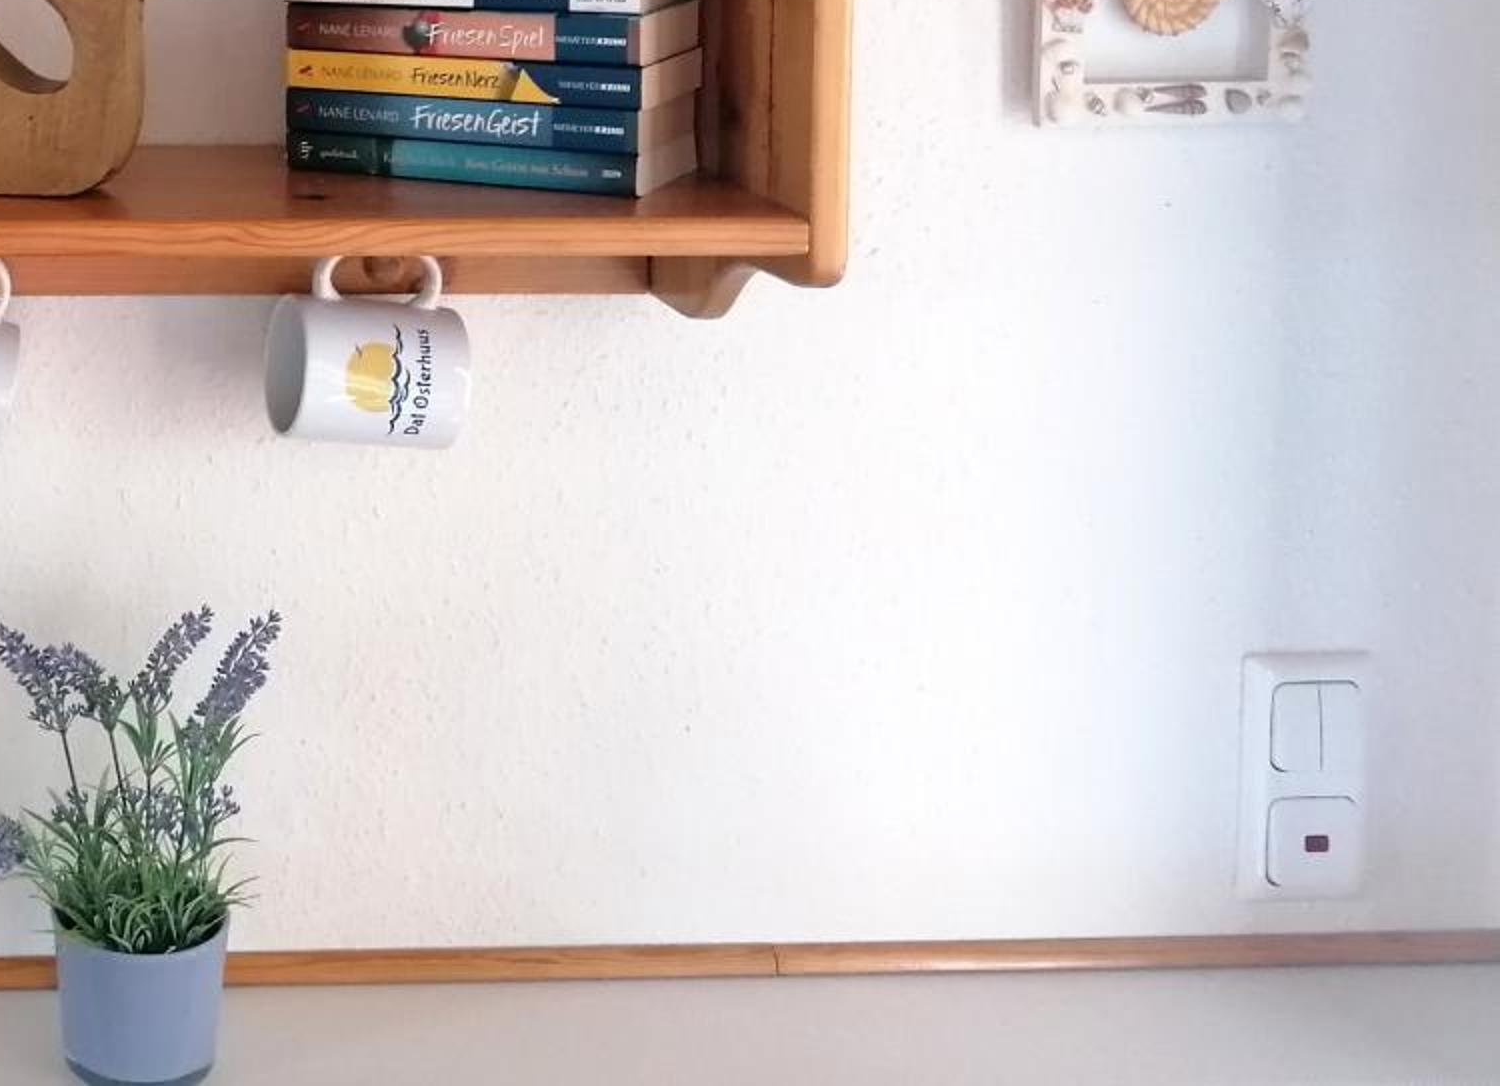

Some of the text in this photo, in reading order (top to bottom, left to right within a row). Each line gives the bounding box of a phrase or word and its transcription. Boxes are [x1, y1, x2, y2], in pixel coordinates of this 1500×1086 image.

[426, 22, 544, 55] FriesenSpiel
[412, 68, 500, 90] FriesenNerz
[409, 103, 544, 138] FriesenGeist
[403, 329, 432, 435] Dat Osterhuus
